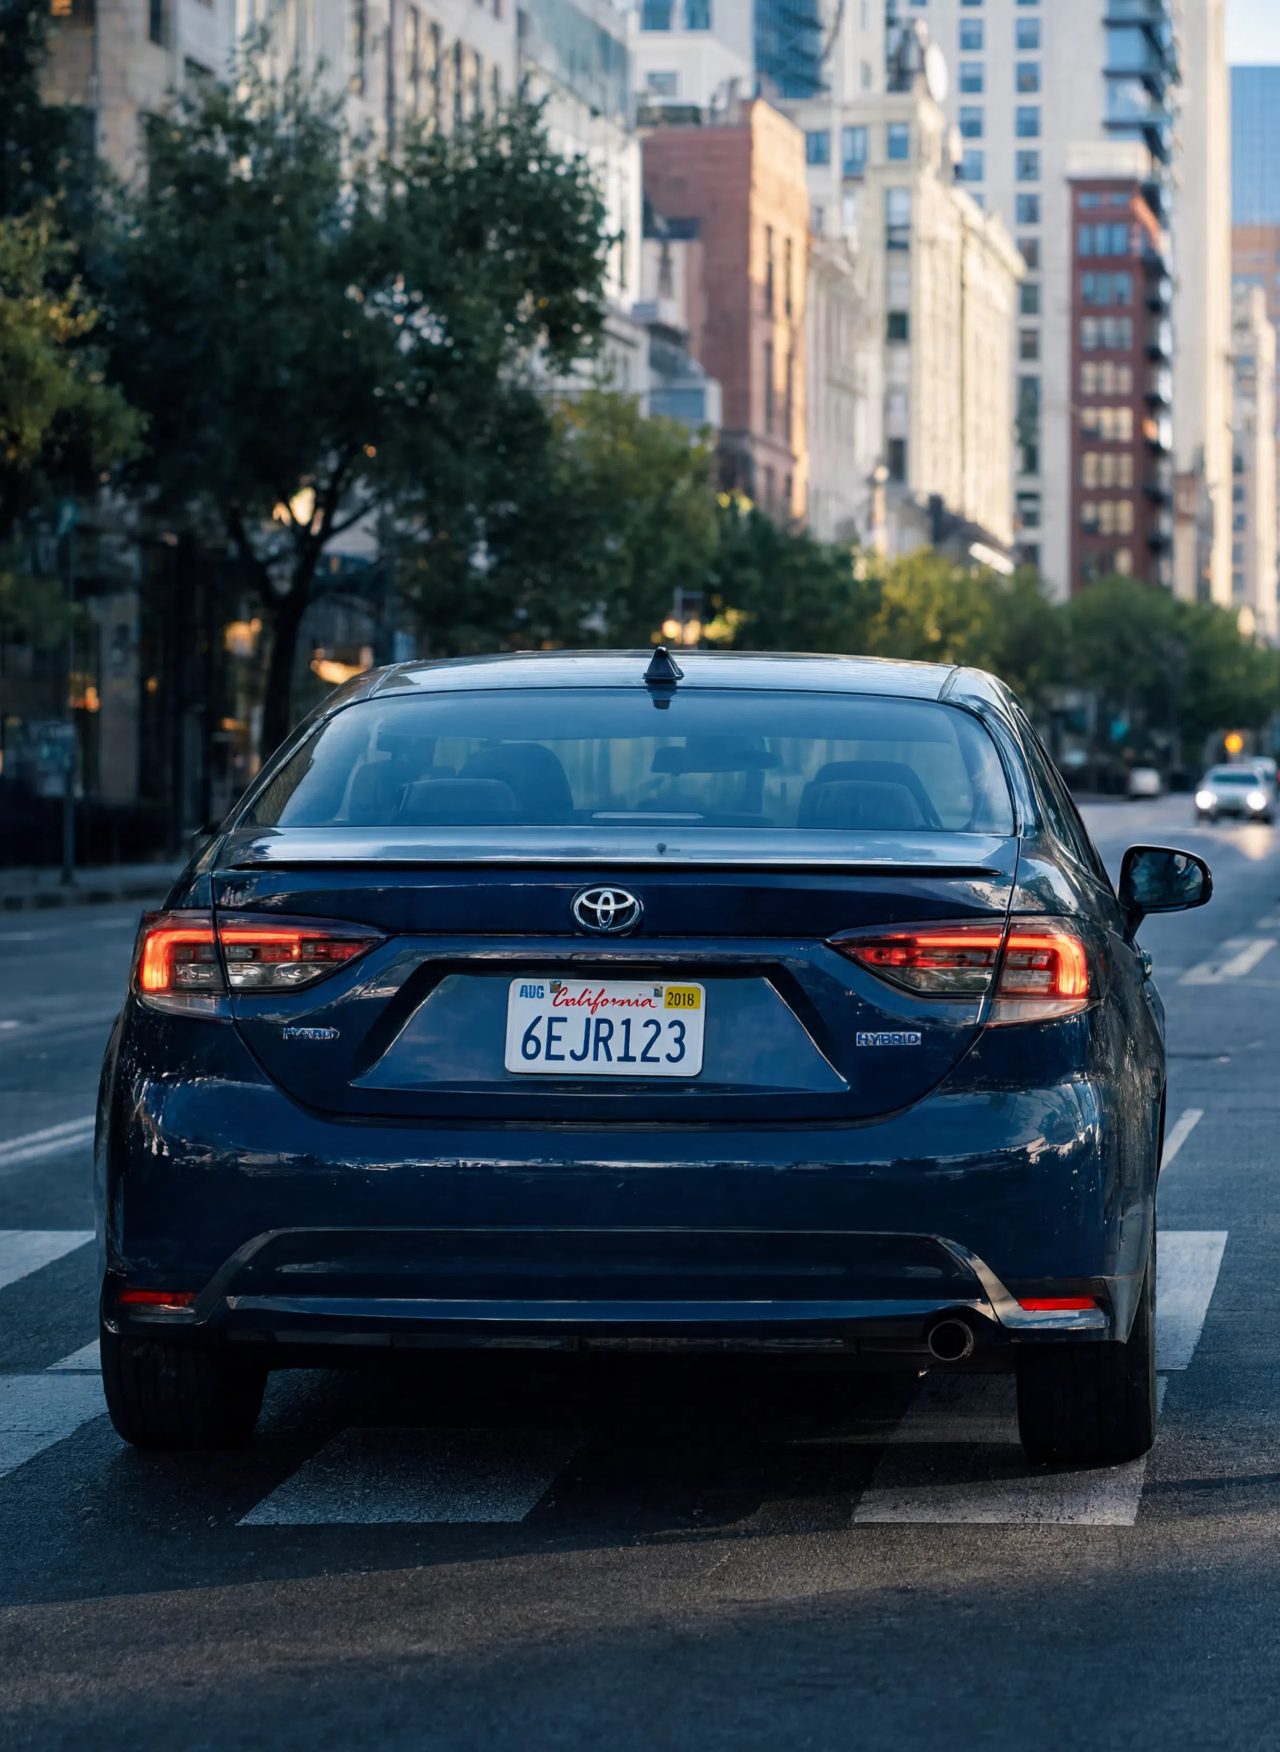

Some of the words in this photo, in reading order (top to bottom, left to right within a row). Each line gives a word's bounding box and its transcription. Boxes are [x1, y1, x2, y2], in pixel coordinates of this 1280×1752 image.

[519, 984, 545, 999] AUG
[667, 991, 695, 1007] 2018
[552, 986, 658, 1015] California
[521, 1015, 686, 1063] 6EJR123
[856, 1032, 921, 1046] HYBRID
